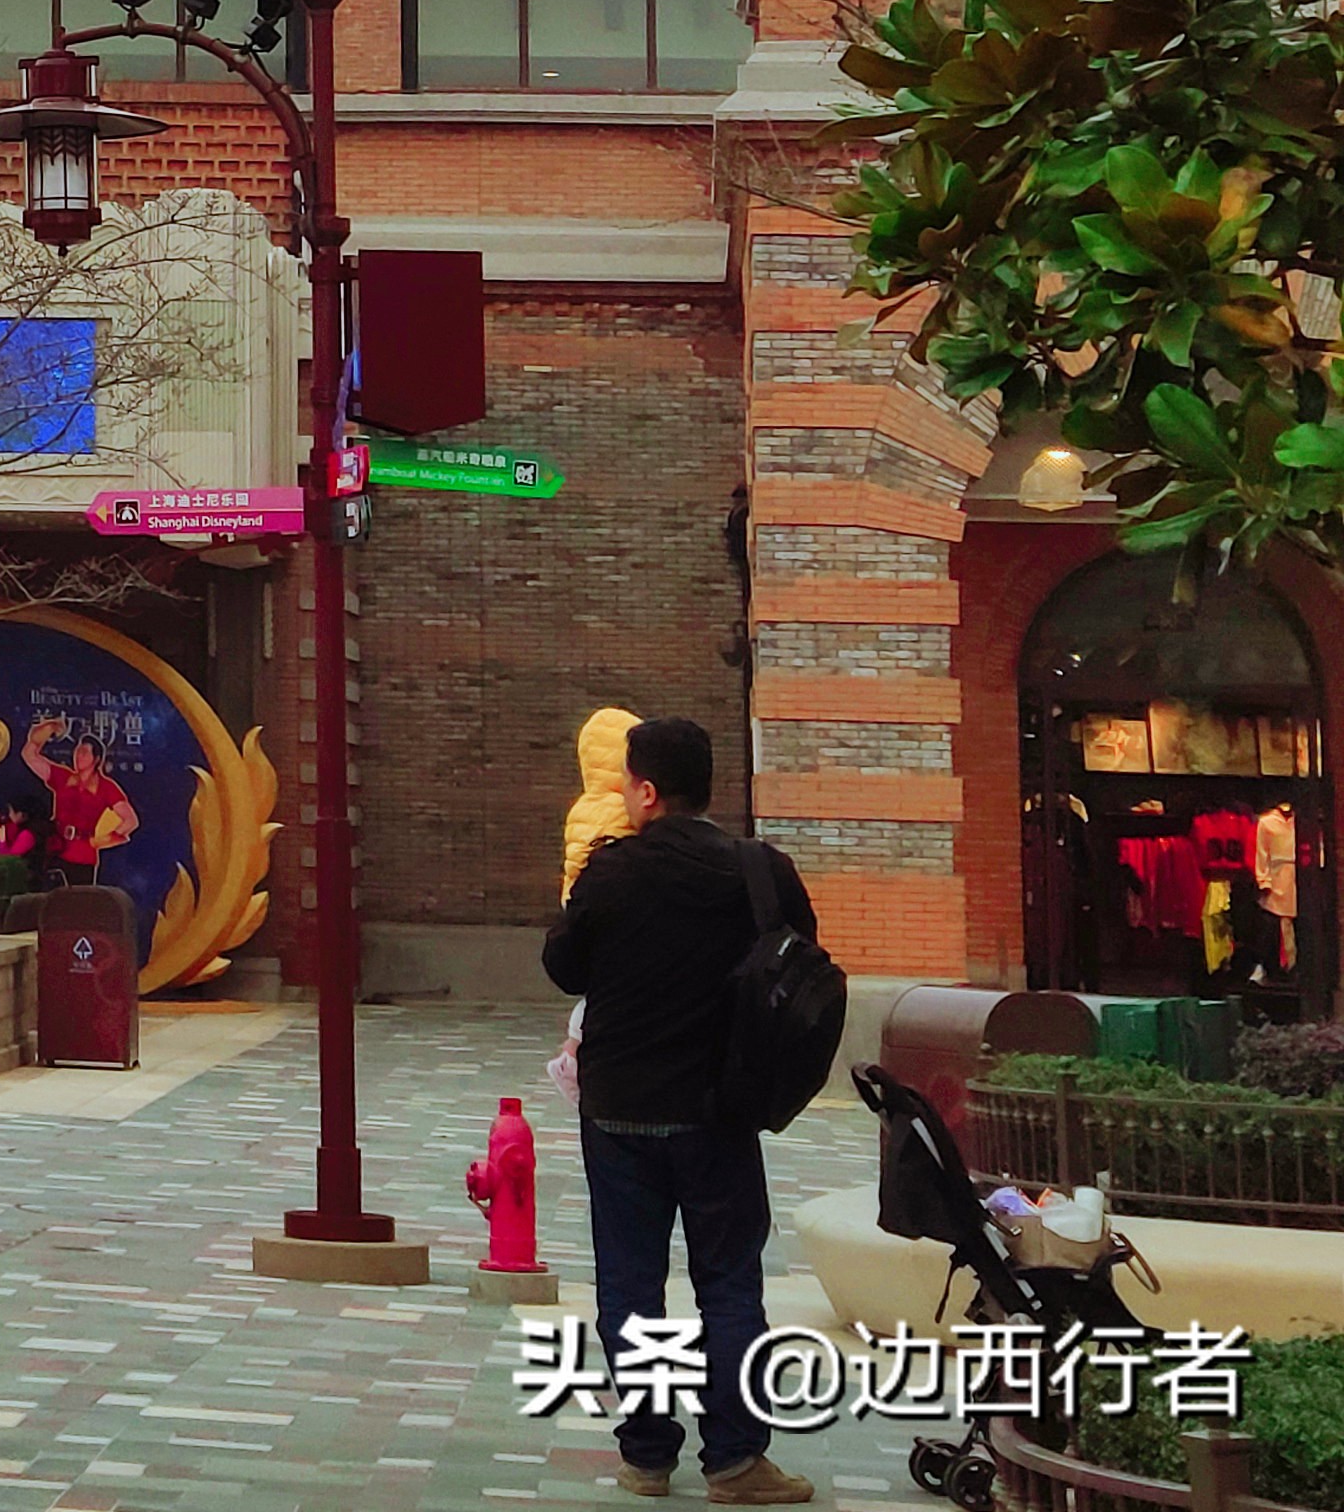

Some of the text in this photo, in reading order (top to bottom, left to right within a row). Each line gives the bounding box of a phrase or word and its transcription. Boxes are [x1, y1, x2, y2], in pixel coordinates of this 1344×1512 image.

[148, 492, 250, 508] 上海迪士尼乐园
[148, 515, 263, 530] Shanghai Disneyland
